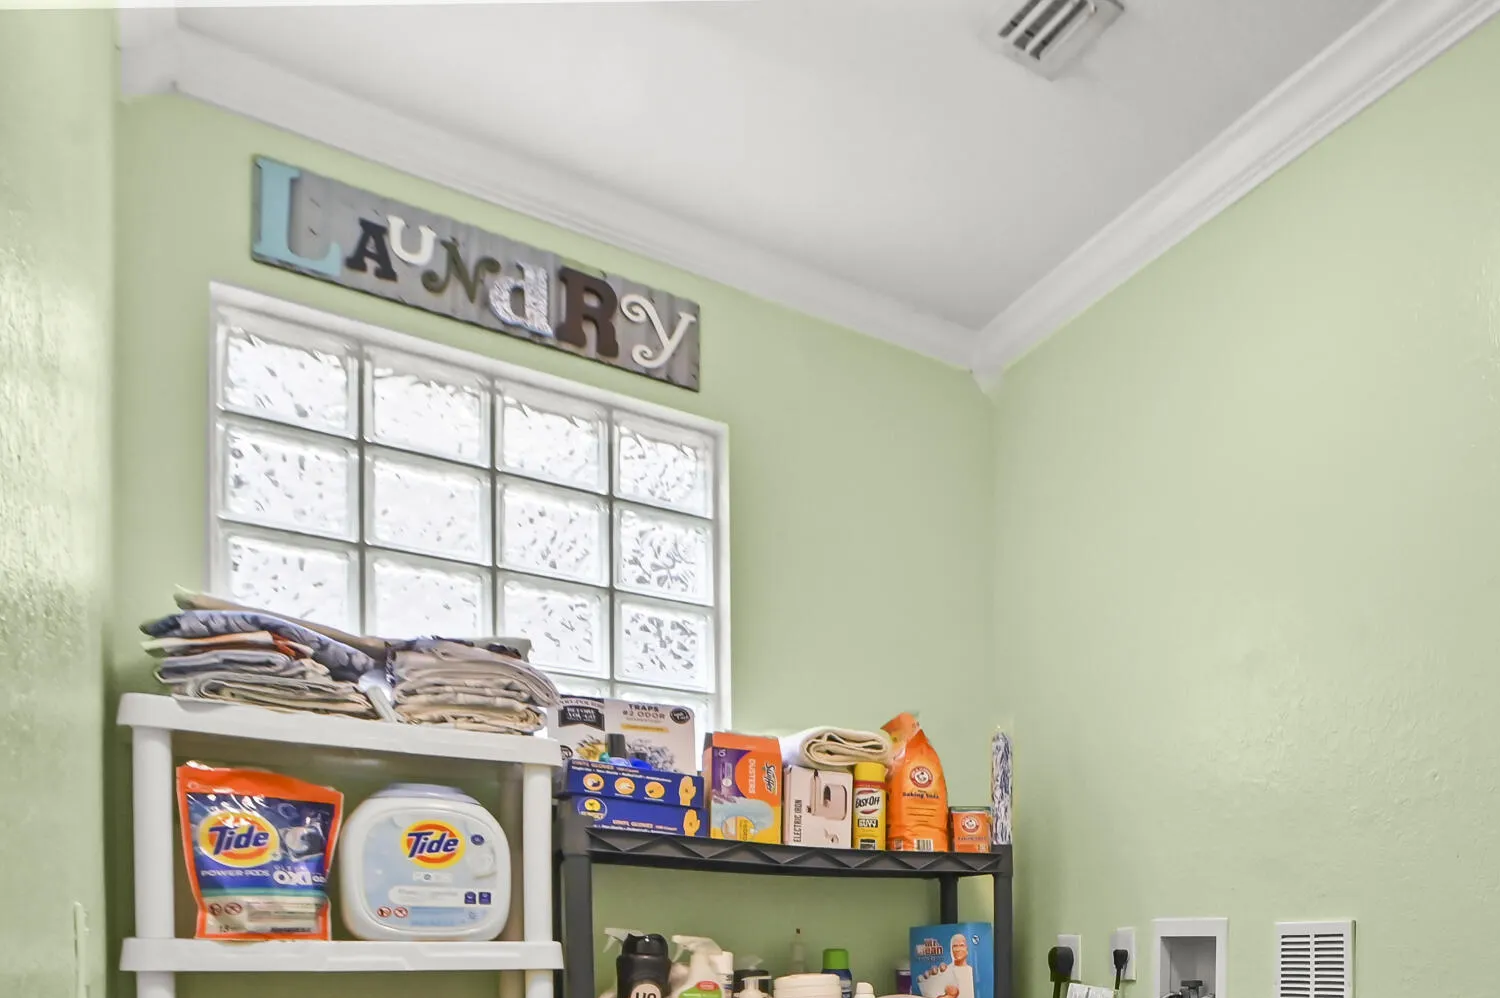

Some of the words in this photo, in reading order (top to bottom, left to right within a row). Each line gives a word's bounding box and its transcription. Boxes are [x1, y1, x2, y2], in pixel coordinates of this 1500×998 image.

[628, 703, 660, 713] TRAPS
[637, 710, 666, 721] ODOR
[748, 758, 756, 794] DUSTERS
[762, 762, 778, 795] Swiffer
[794, 799, 803, 814] IRON
[208, 825, 270, 856] Tide
[793, 815, 802, 843] ELECTRIC
[407, 831, 460, 859] Tide
[272, 869, 313, 886] OXI
